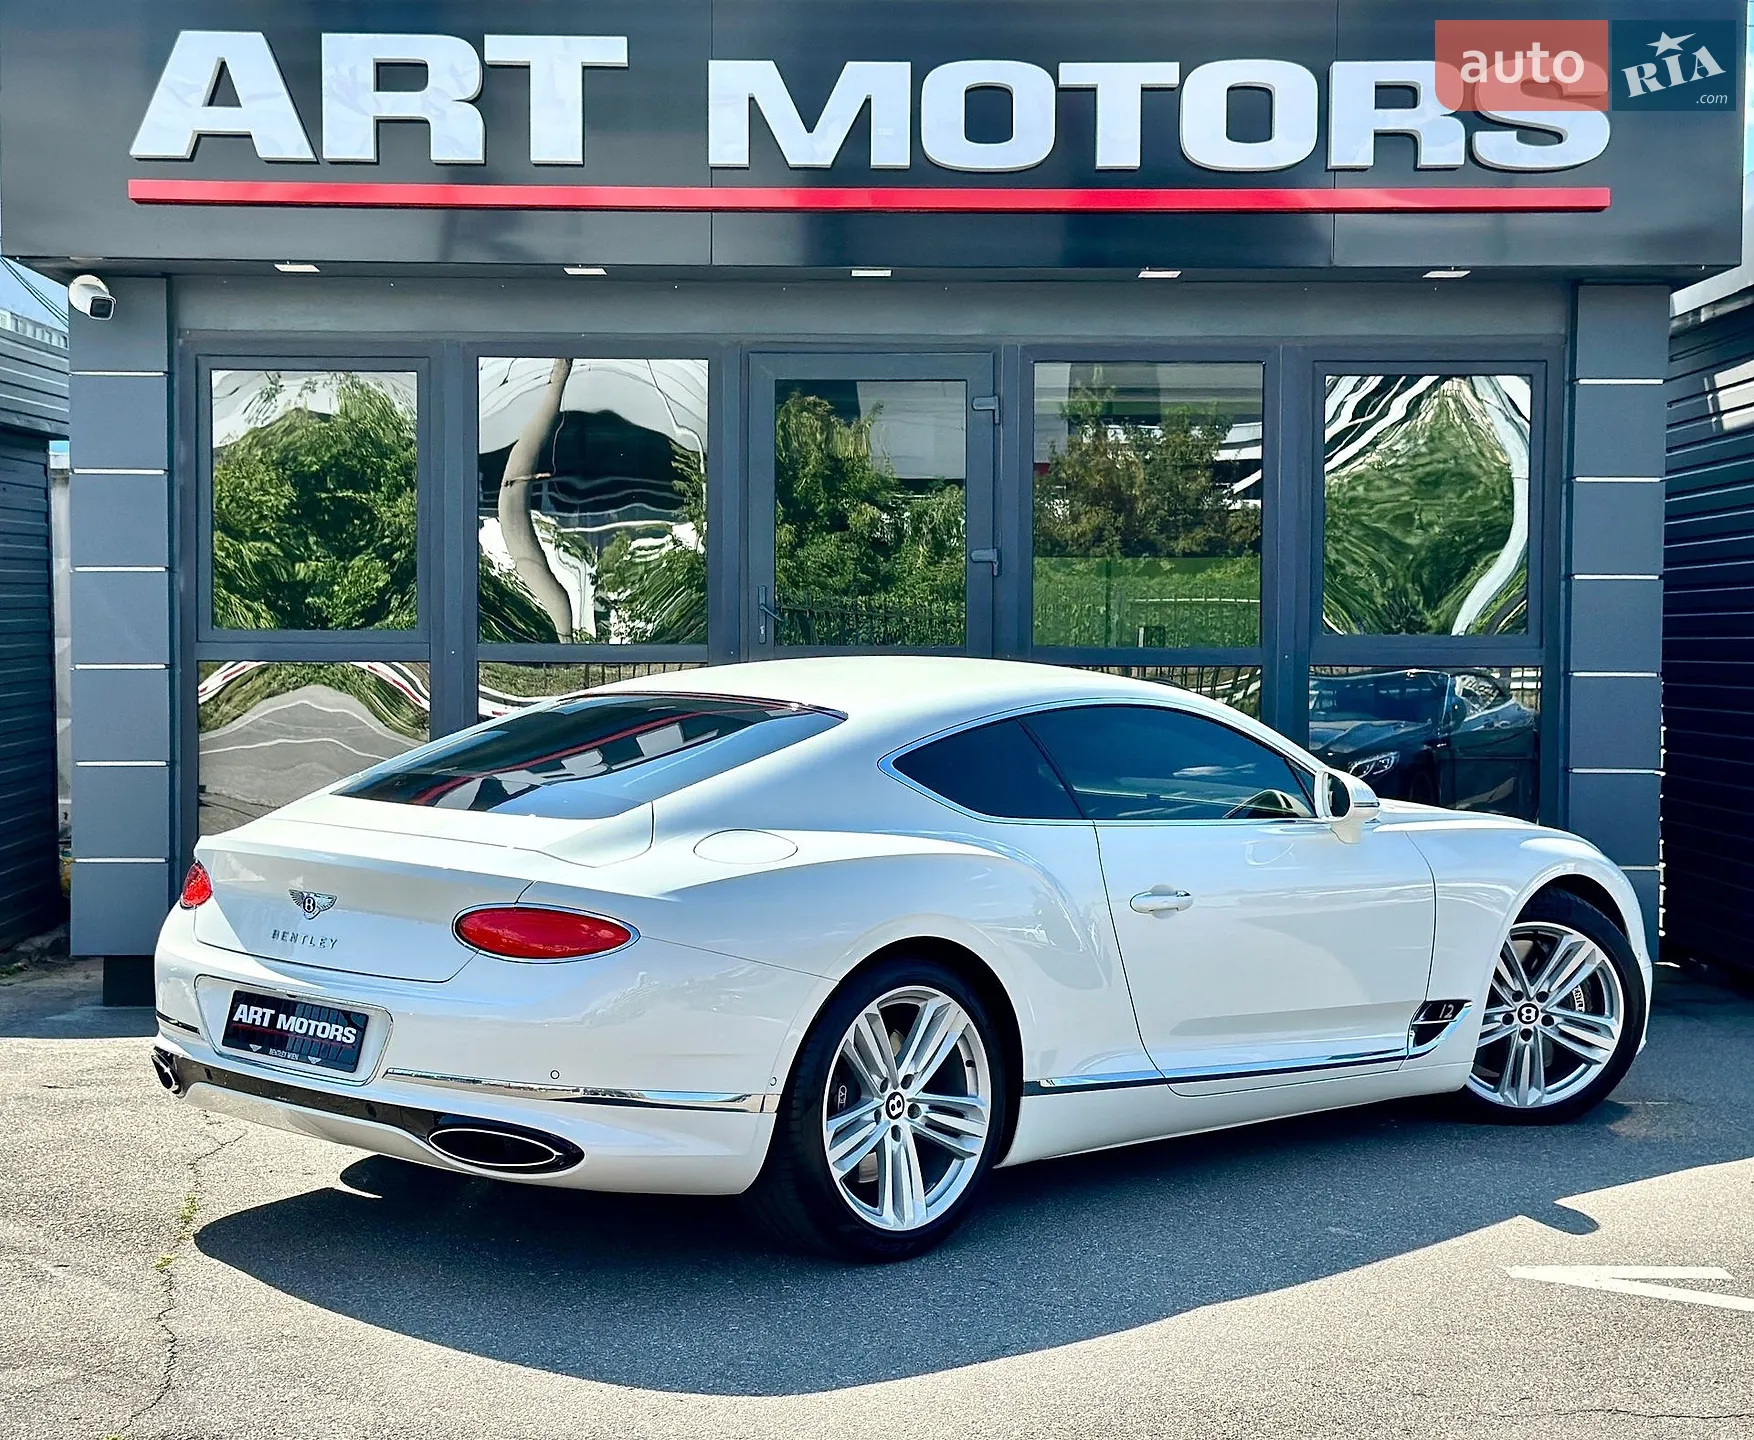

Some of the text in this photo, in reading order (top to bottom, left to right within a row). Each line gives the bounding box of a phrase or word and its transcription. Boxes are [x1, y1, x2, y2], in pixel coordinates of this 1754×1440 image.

[130, 30, 1610, 171] ART MOTORS
[272, 929, 338, 949] BENTLEY
[233, 1003, 357, 1044] ART MOTORS
